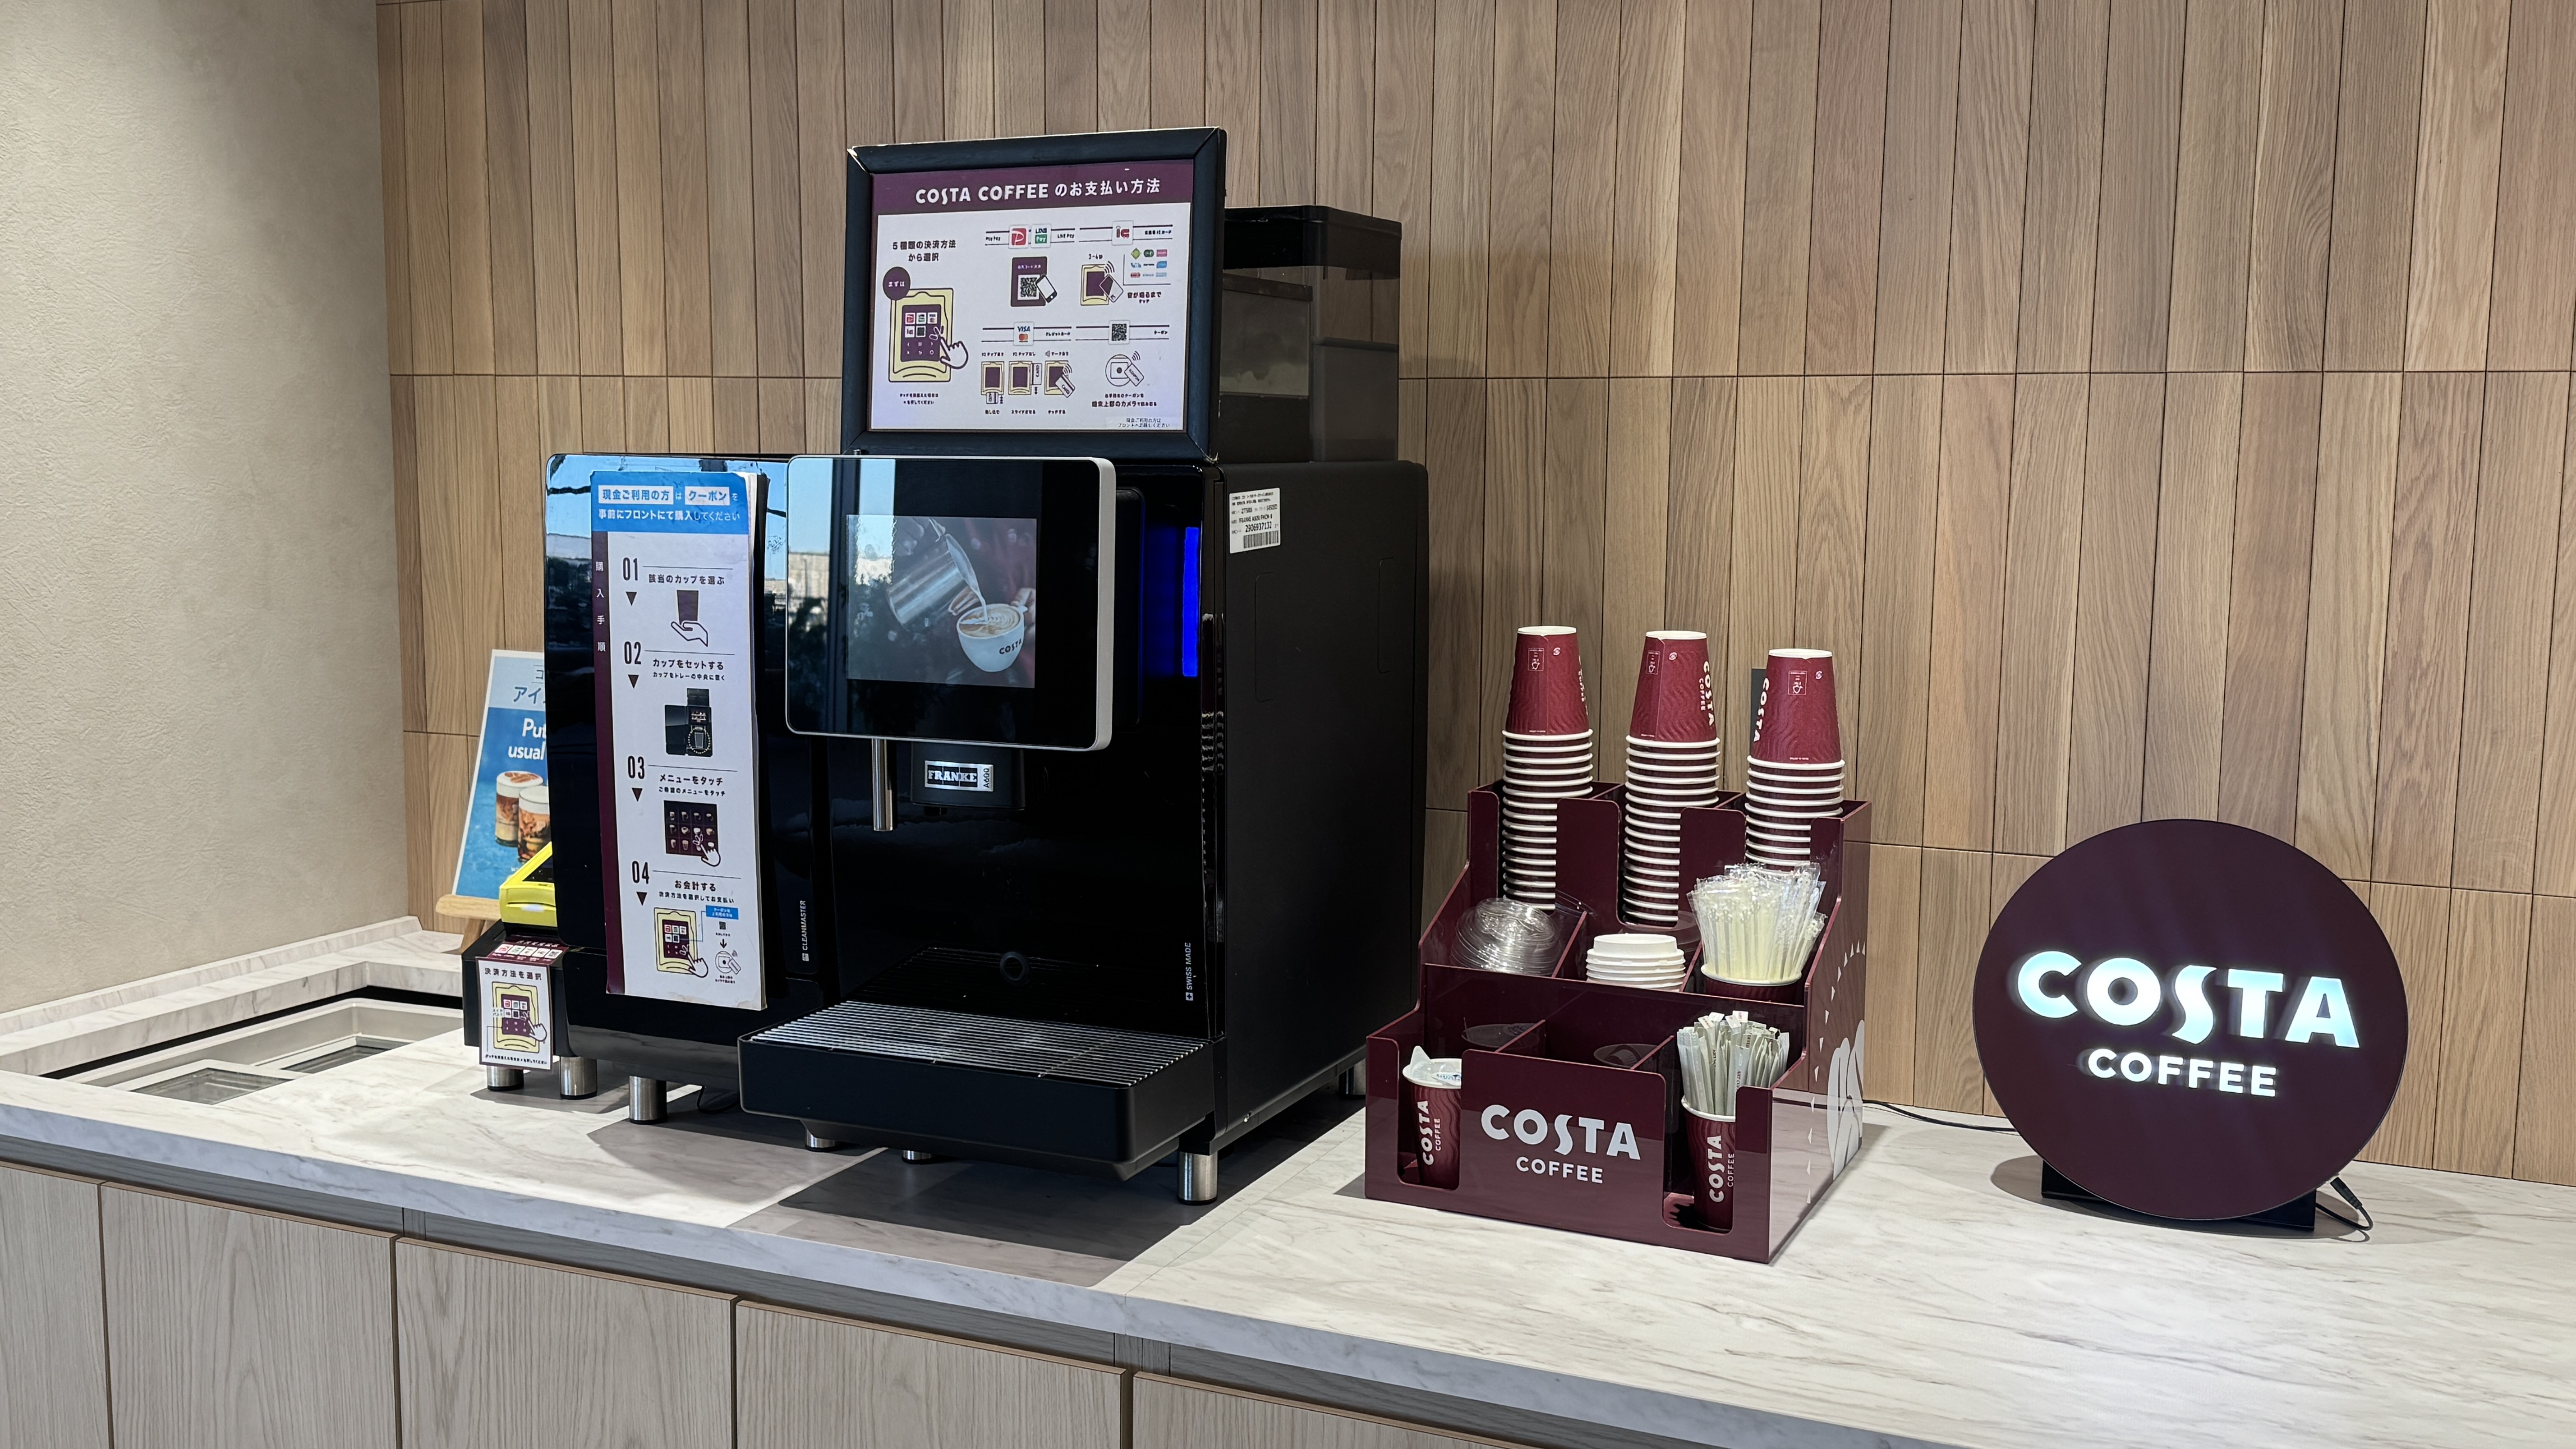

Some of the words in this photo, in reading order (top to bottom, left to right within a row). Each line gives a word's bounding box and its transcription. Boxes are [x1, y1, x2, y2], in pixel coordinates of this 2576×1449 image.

[916, 187, 971, 205] COSTA
[978, 184, 1049, 201] COFFEE
[1055, 178, 1160, 197] のお支払い方法
[602, 489, 670, 501] 現金ご利用の方
[688, 490, 727, 501] クーポン
[598, 508, 741, 521] 事前にフロントにて購入してください
[622, 557, 638, 581] 01
[649, 573, 725, 585] 該当のカップを選ぶ
[624, 641, 642, 665] 02
[653, 659, 724, 671] カップをセットする
[513, 685, 545, 704] アイ
[508, 741, 546, 760] usual
[627, 755, 645, 779] 03
[928, 769, 977, 782] FRANKE
[659, 774, 723, 786] メニューをタッチ
[631, 860, 650, 884] 04
[675, 879, 716, 892] お会計する
[800, 900, 808, 951] CLEANMASTER
[484, 967, 542, 980] 決済方法を選択
[2016, 950, 2360, 1049] COSTA
[2087, 1047, 2277, 1098] COFFEE
[1417, 1100, 1435, 1165] COSTA
[1480, 1104, 1642, 1160] COSTA
[1516, 1156, 1604, 1185] COFFEE
[1707, 1135, 1725, 1203] COSTA
